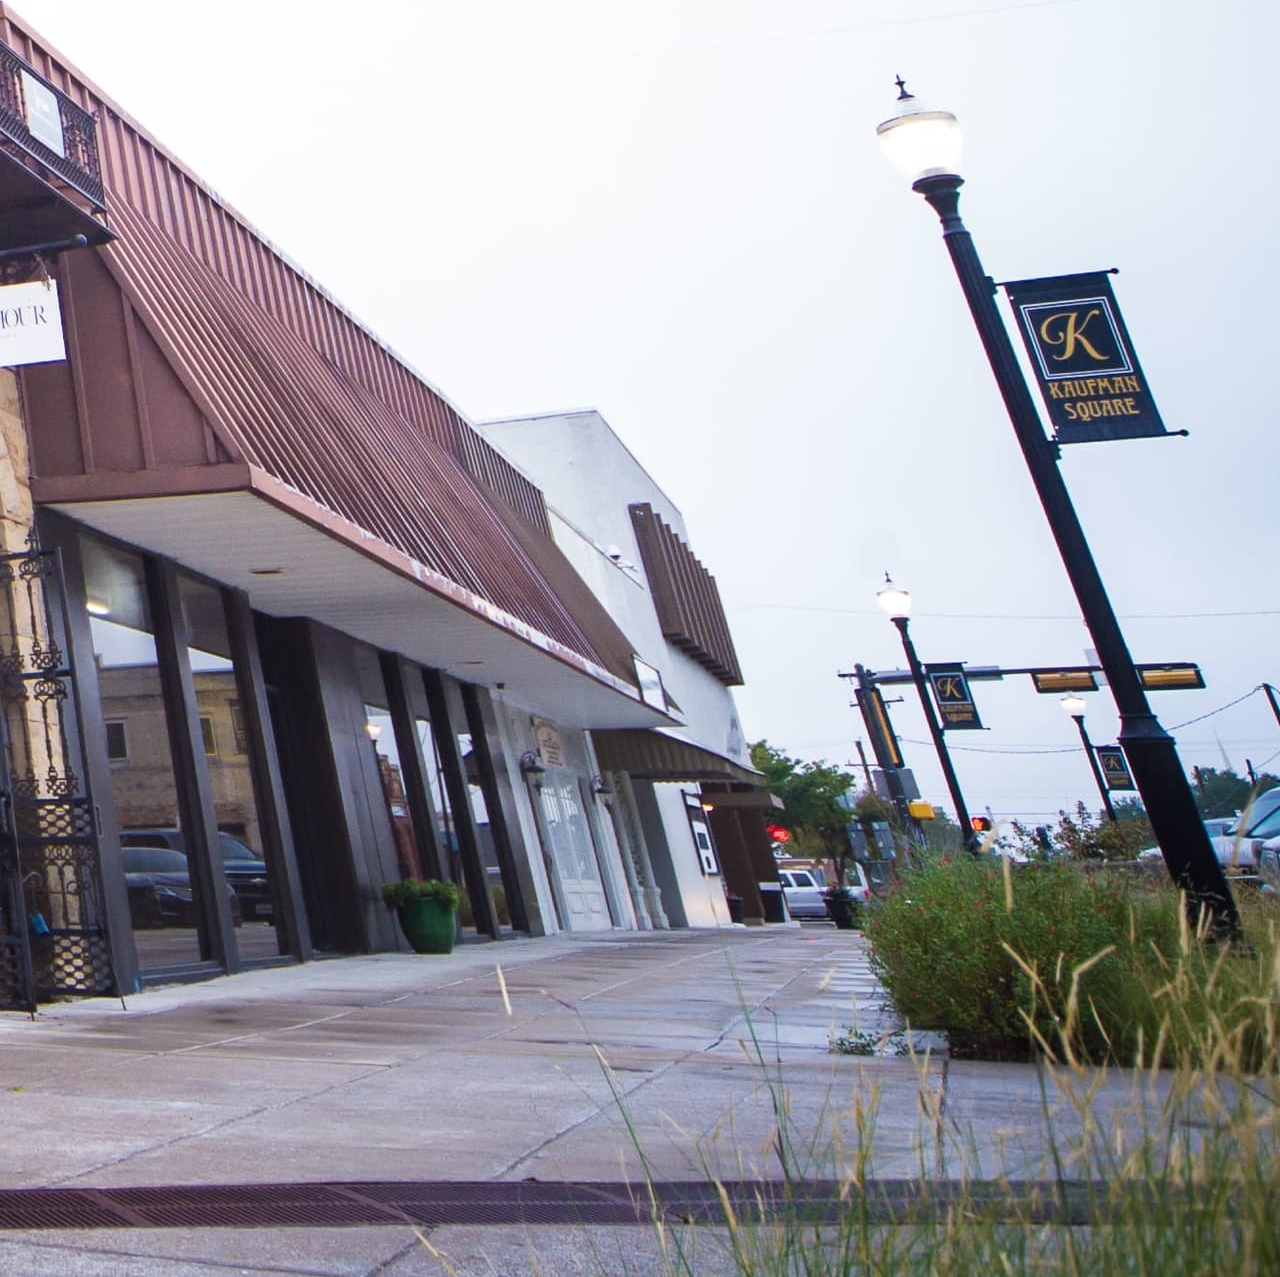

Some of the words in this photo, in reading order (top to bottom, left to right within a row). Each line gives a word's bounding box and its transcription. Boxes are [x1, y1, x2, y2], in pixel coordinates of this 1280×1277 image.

[1040, 308, 1111, 361] K
[1048, 375, 1141, 399] KAUFMAN
[1064, 398, 1140, 421] SQUARE
